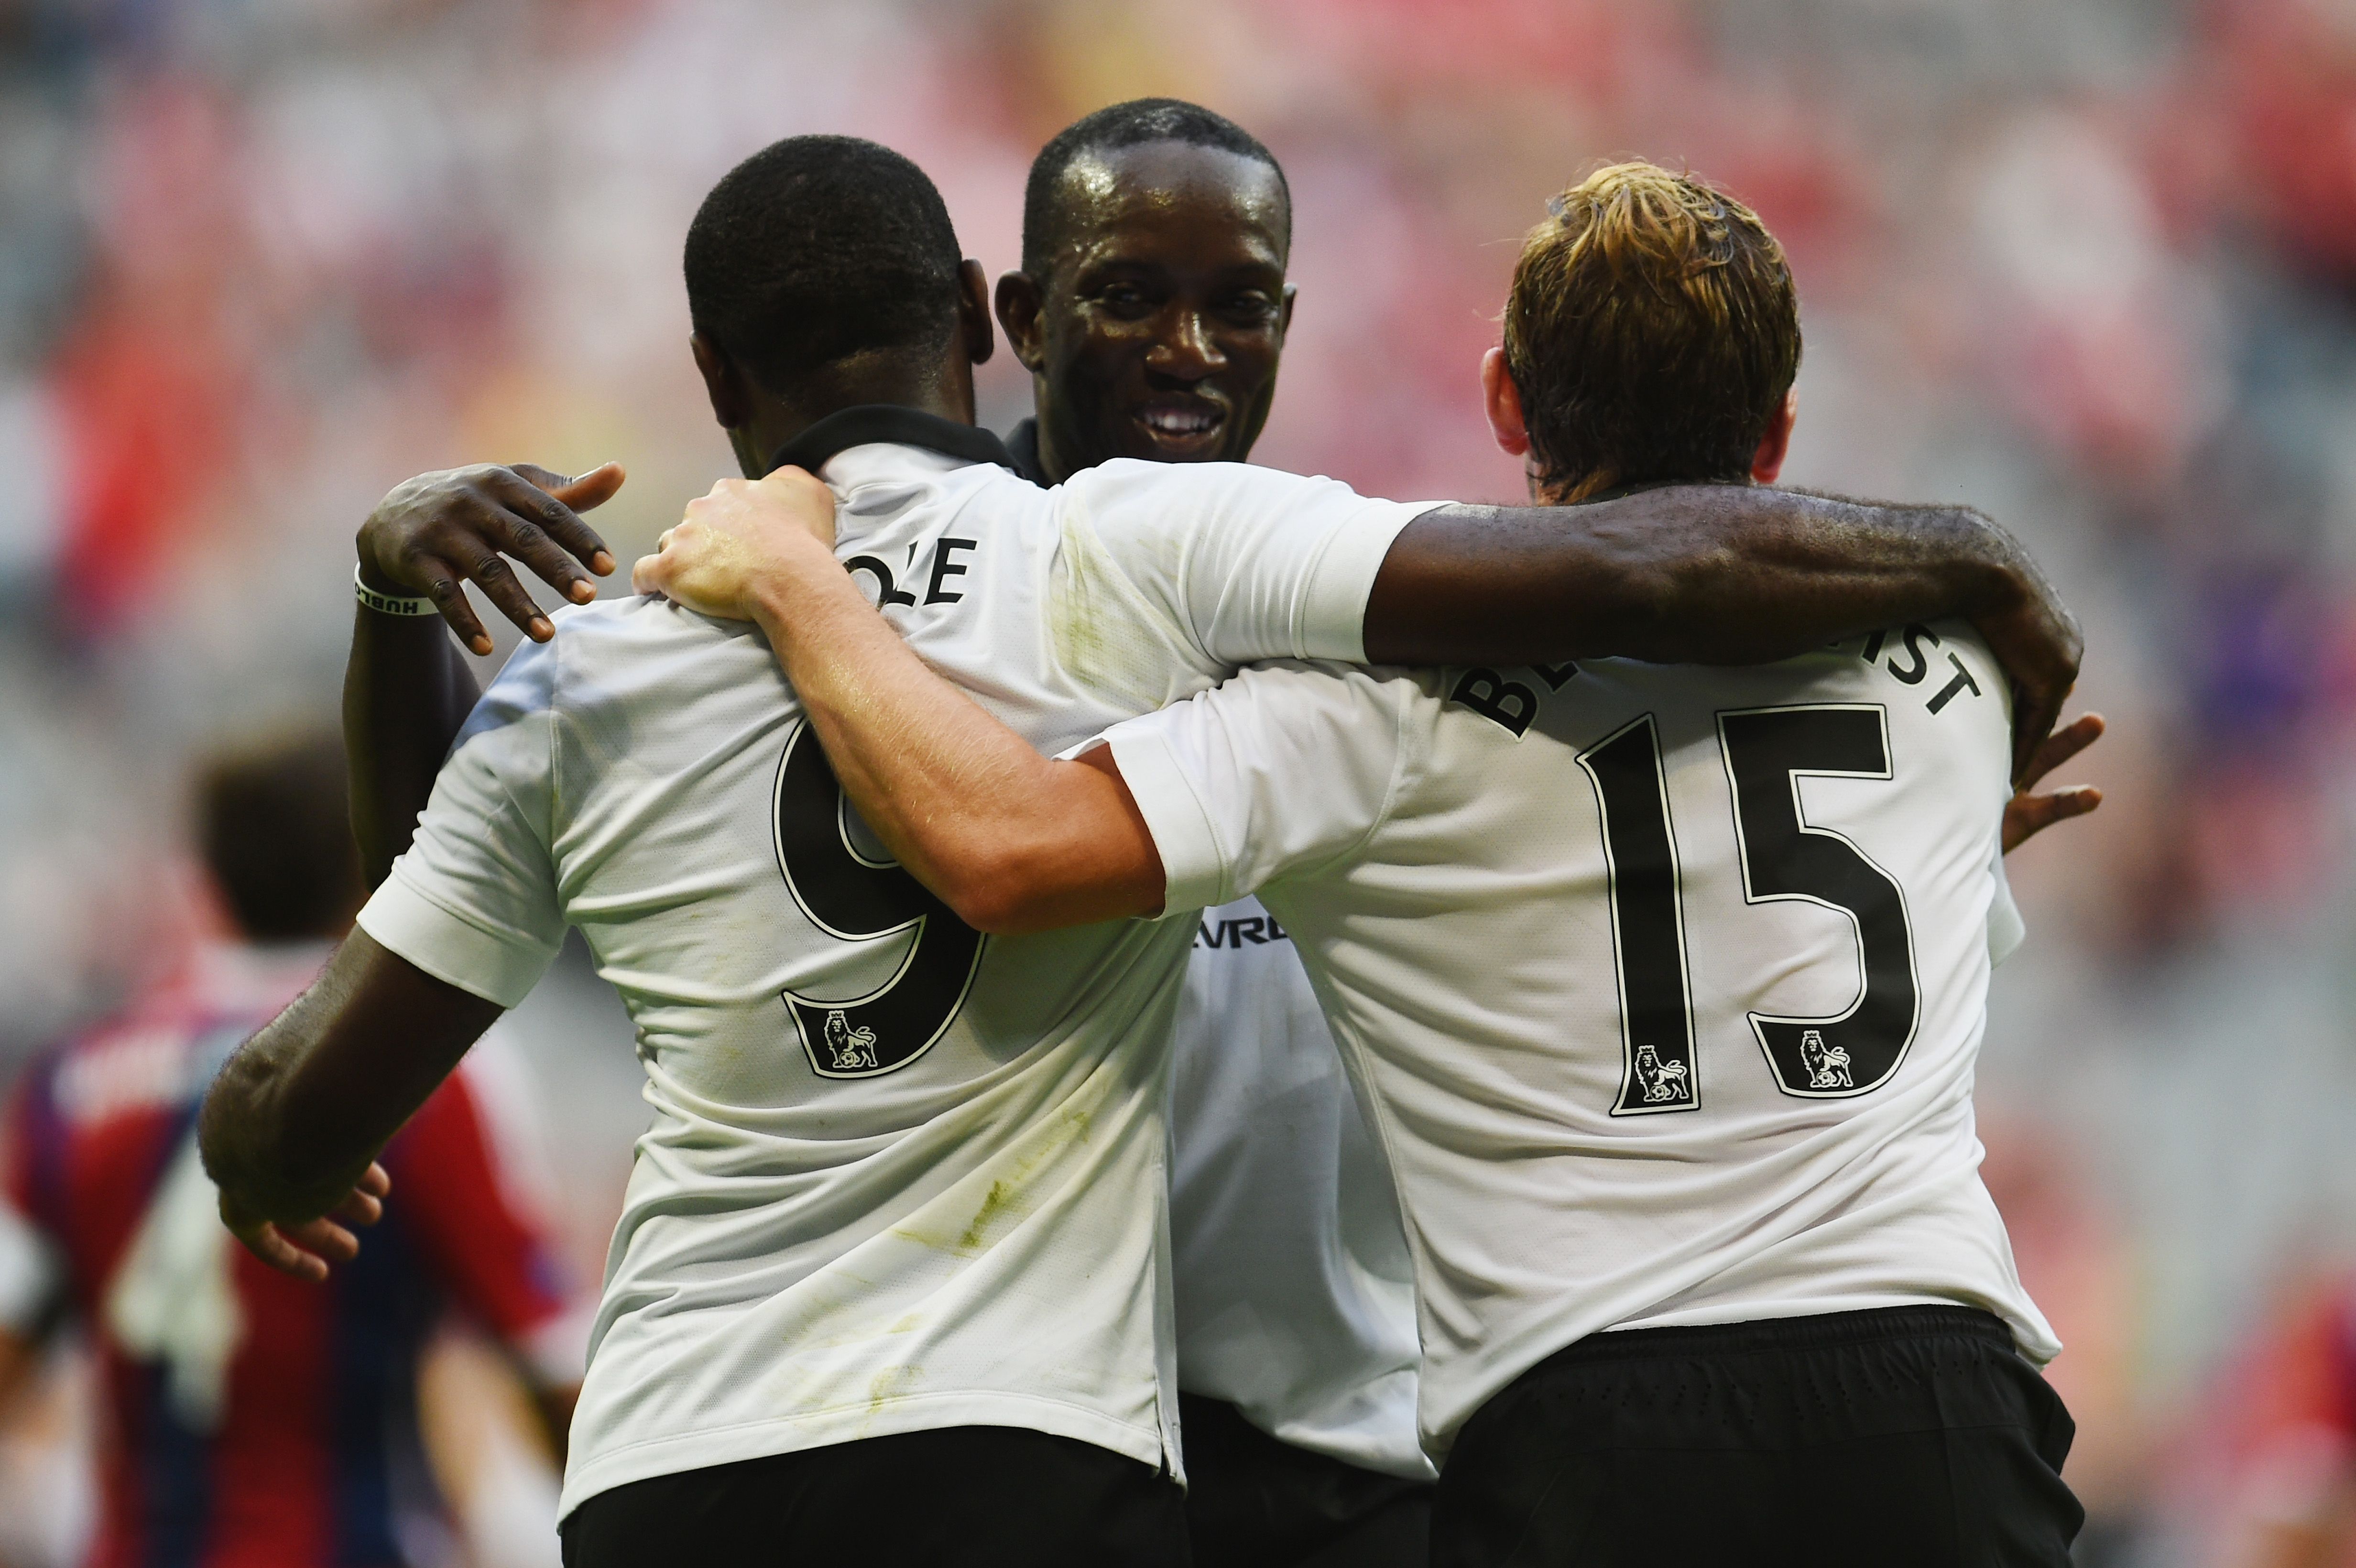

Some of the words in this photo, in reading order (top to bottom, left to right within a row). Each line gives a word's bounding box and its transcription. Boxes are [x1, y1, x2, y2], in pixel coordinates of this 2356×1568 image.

[842, 537, 977, 611] OLE
[772, 716, 989, 1079] 9
[1574, 703, 1921, 1117] 15
